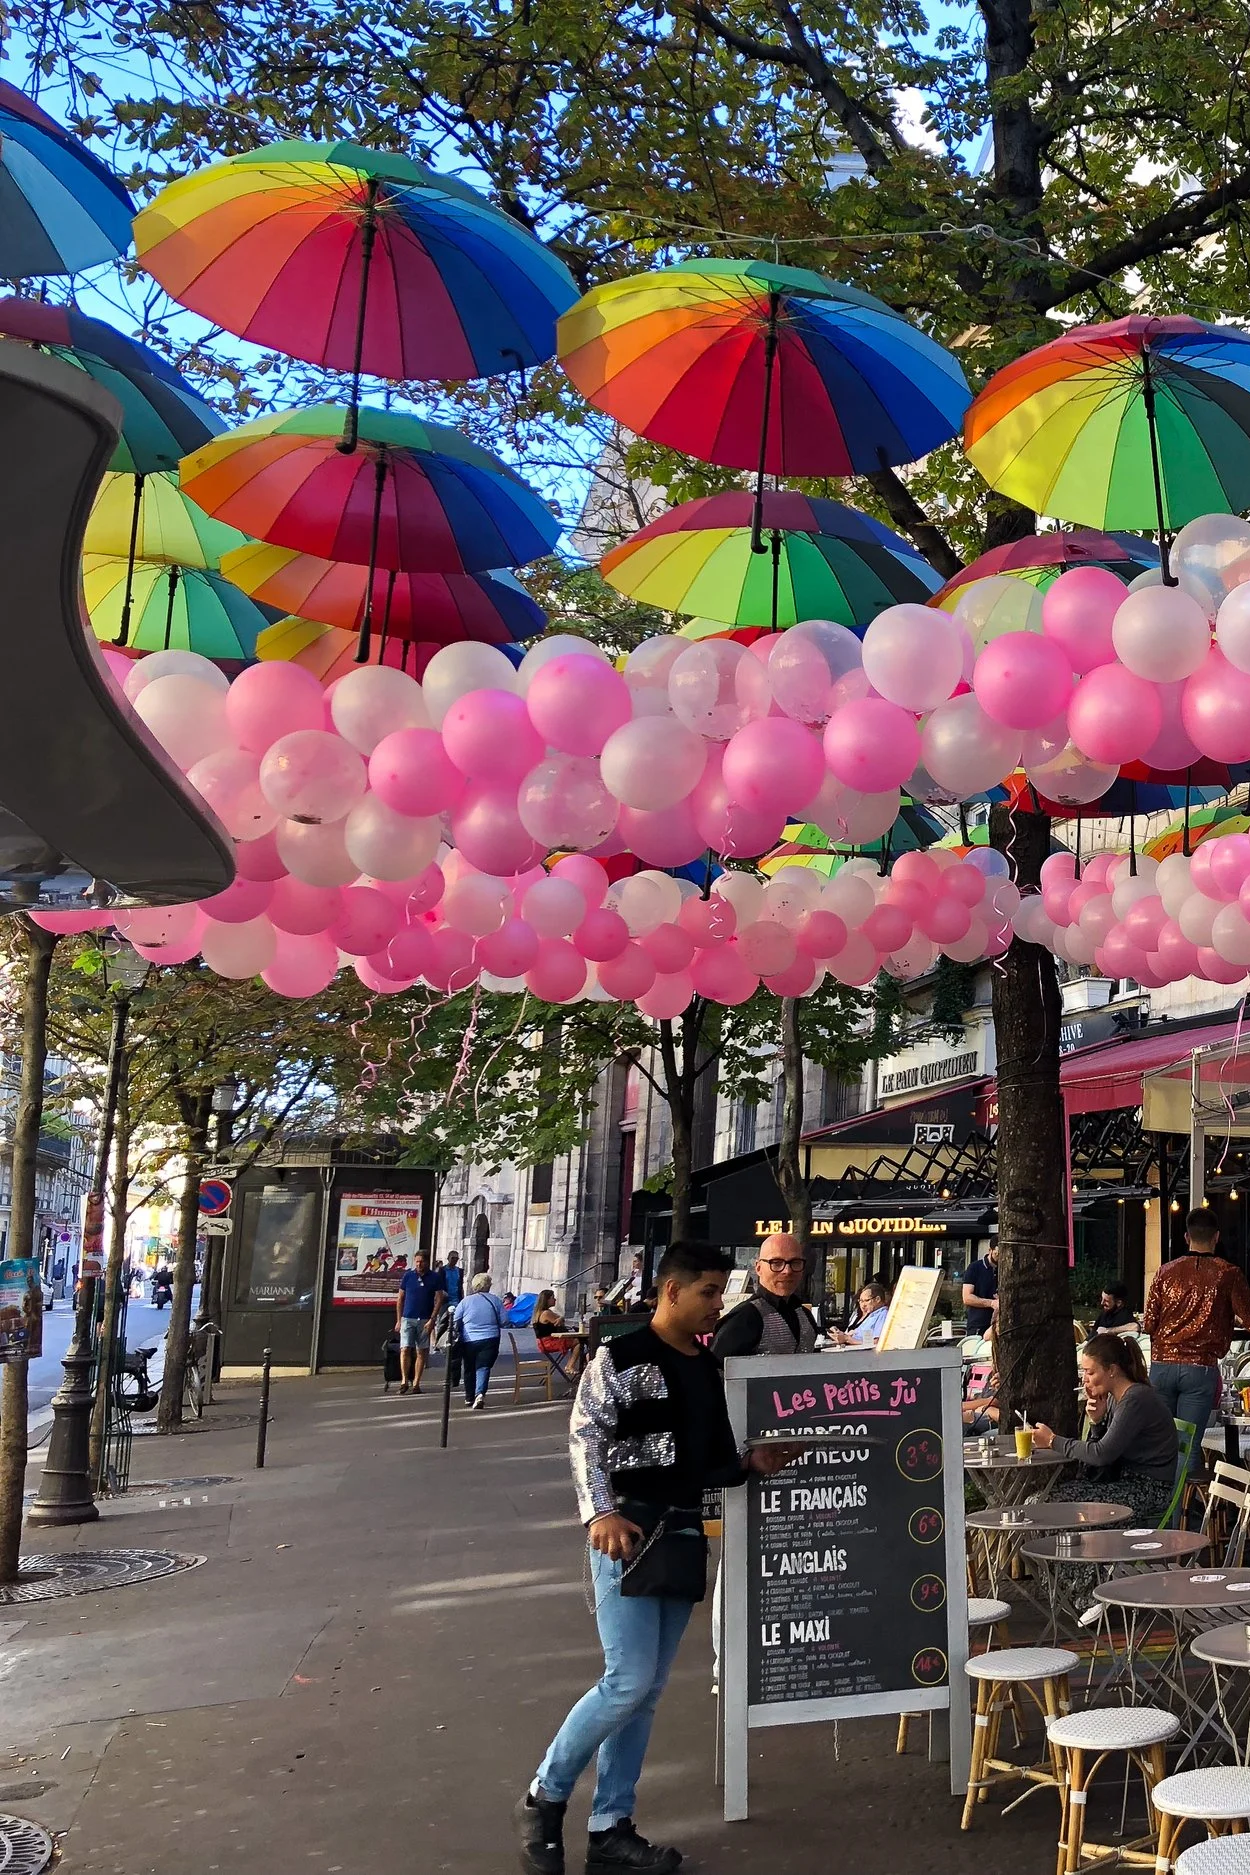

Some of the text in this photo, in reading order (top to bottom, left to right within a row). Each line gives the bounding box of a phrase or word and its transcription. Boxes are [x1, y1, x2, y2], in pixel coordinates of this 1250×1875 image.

[1059, 1023, 1084, 1042] HIVE
[881, 1051, 978, 1093] LE PAIN QUOTIDIEN
[755, 1220, 782, 1235] LE
[772, 1389, 816, 1418] Les
[823, 1377, 881, 1411] Petits
[760, 1481, 868, 1514] LE FRANÇAIS
[761, 1544, 848, 1577] L'ANGLAIS
[761, 1615, 830, 1646] LE MAXI
